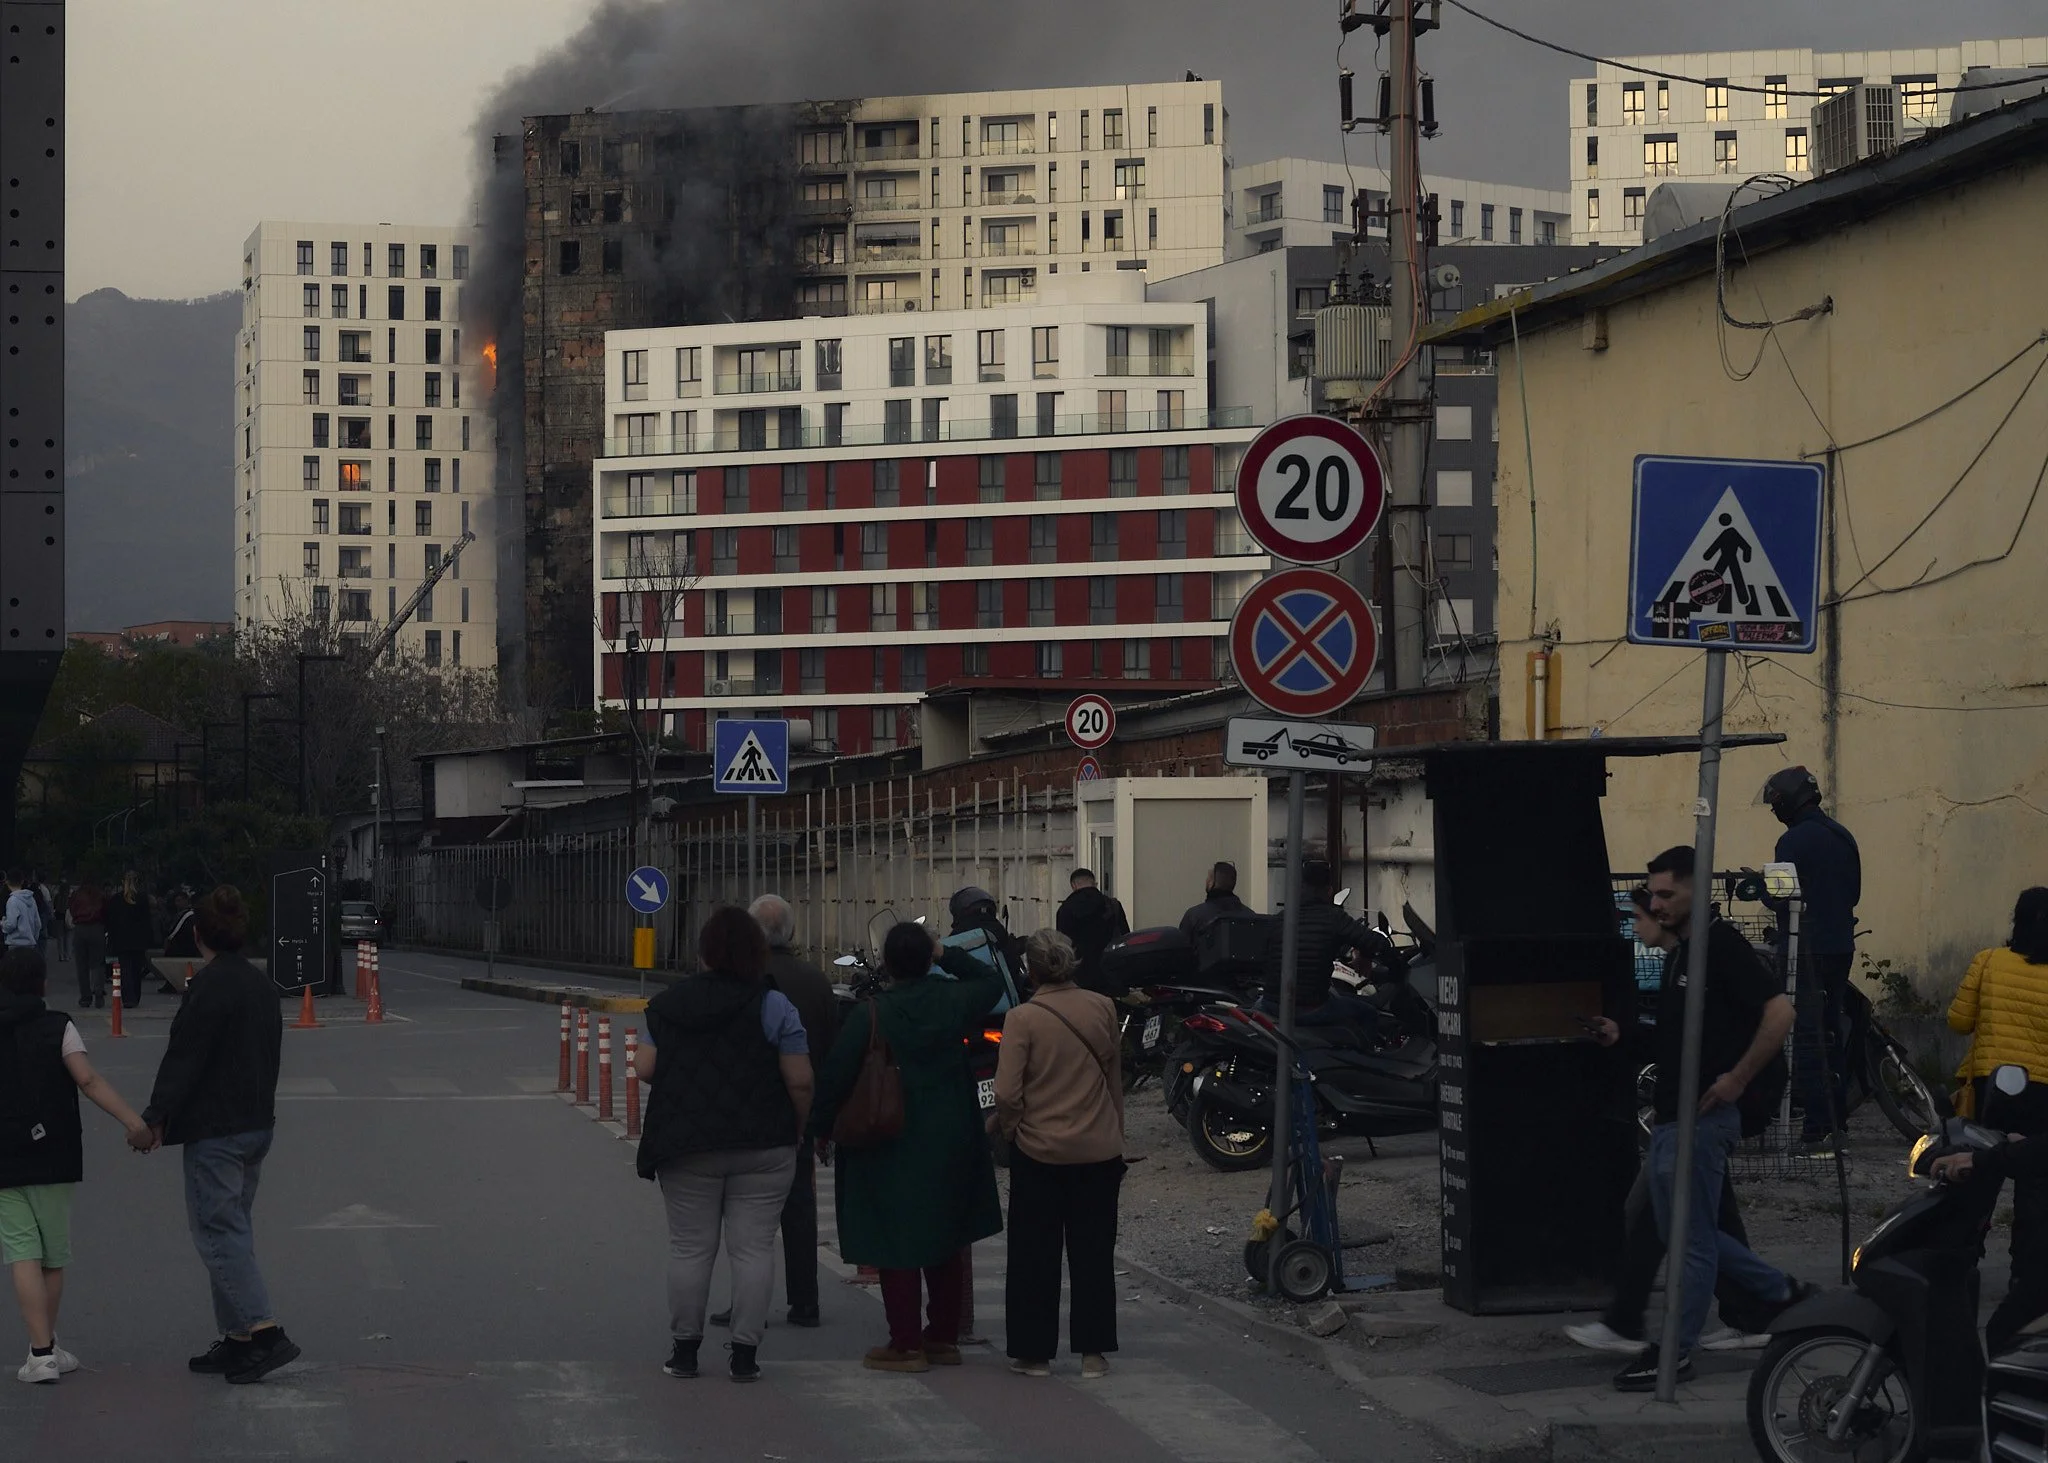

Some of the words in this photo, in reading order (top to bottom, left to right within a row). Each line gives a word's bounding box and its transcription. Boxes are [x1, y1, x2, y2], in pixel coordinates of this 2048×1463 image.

[1275, 454, 1349, 521] 20
[1078, 708, 1104, 733] 20
[981, 1093, 995, 1106] 92
